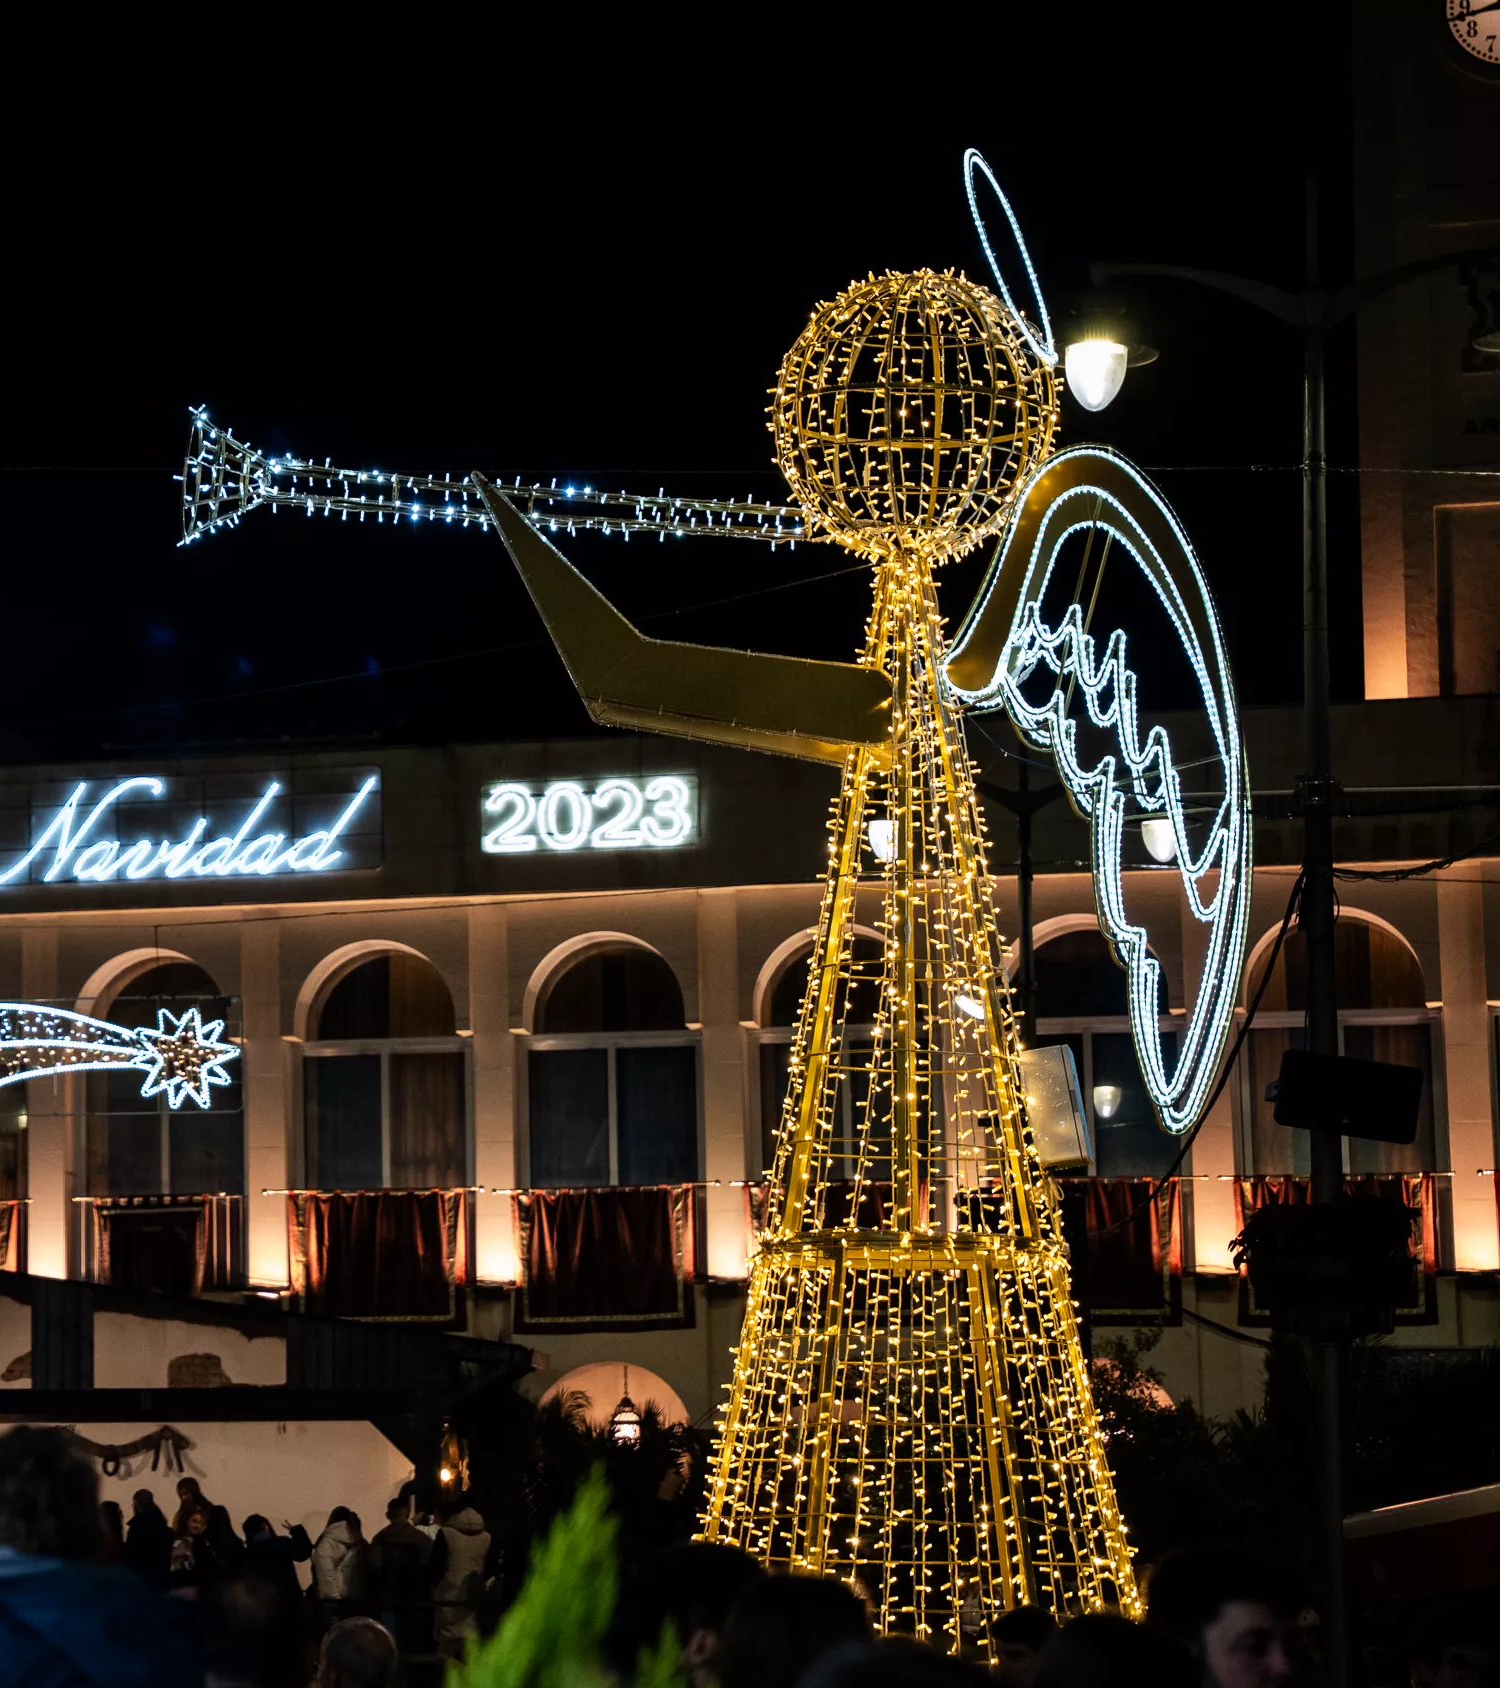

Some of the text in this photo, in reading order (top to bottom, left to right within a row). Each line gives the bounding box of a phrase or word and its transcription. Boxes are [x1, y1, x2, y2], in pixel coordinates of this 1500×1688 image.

[1467, 20, 1477, 38] 8
[1486, 35, 1496, 52] 7
[482, 775, 693, 853] 2023
